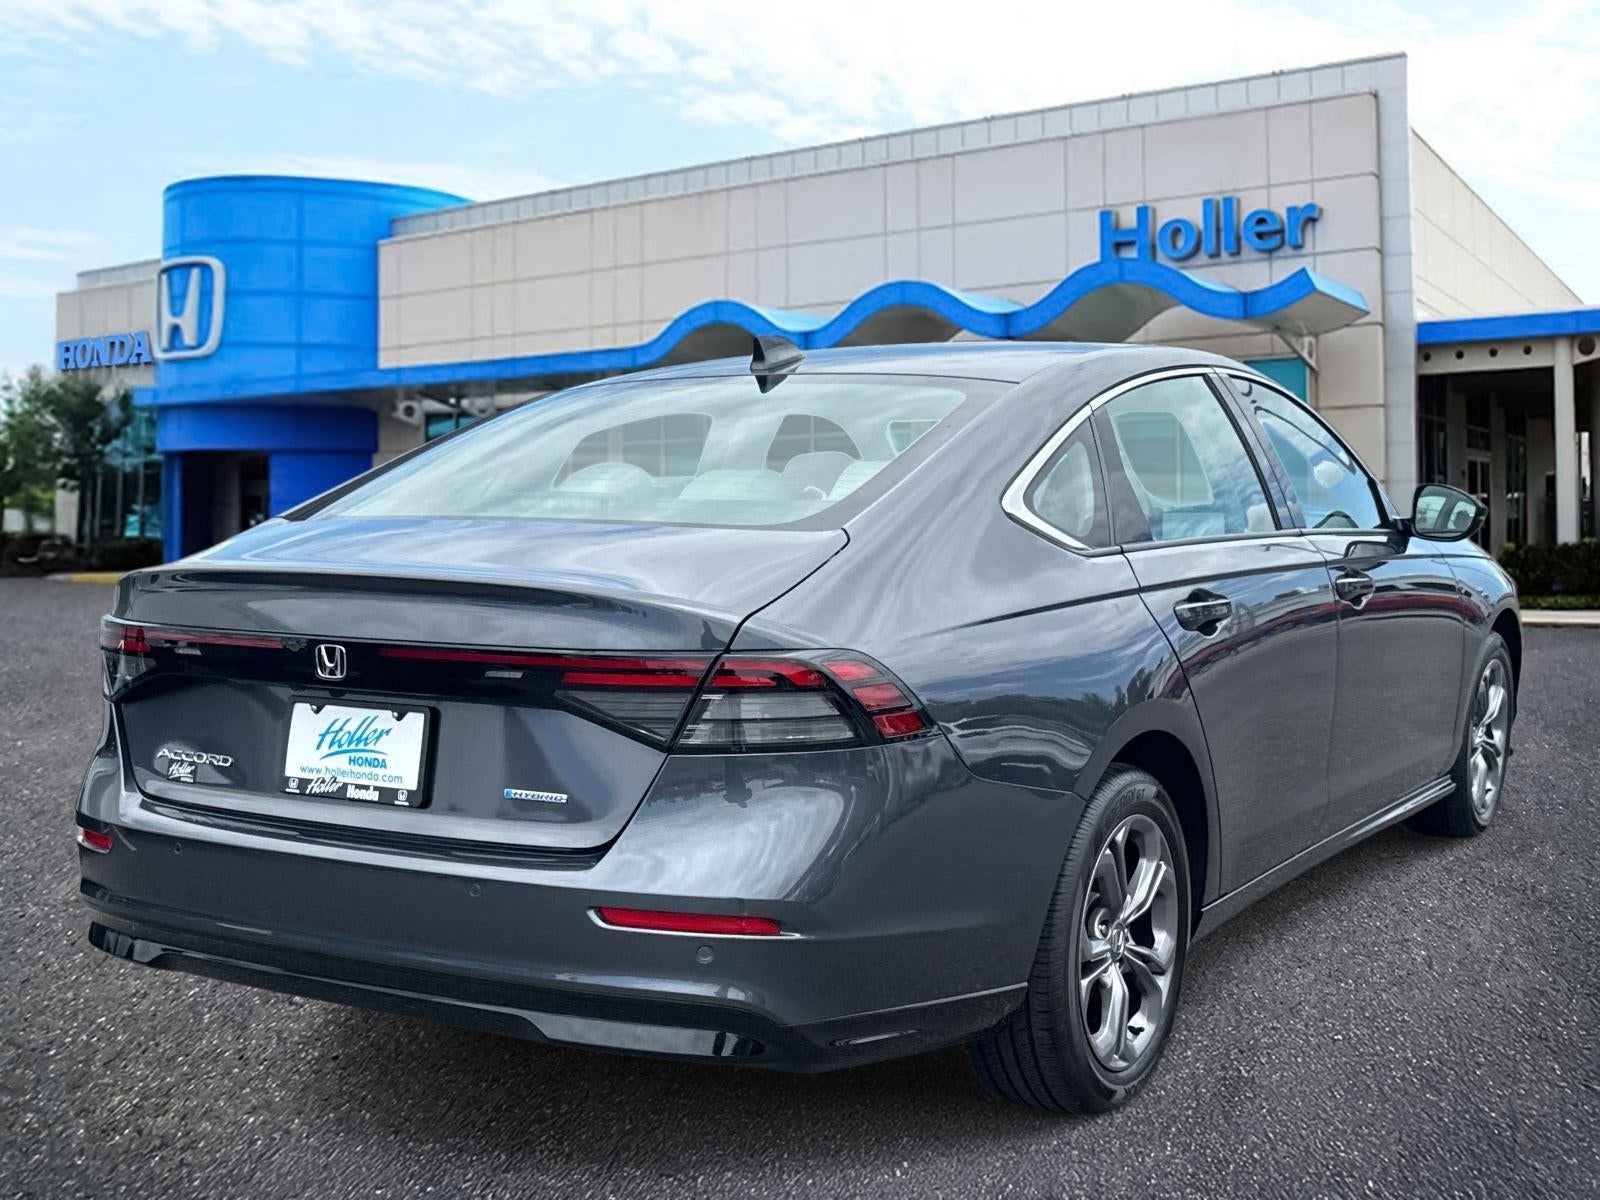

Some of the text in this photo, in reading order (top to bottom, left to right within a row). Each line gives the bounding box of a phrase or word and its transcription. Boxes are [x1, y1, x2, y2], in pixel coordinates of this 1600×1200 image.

[1099, 196, 1320, 262] Holler
[57, 331, 152, 370] HONDA
[315, 714, 393, 751] Holler
[156, 748, 234, 767] ACCORD
[348, 756, 388, 769] HONDA
[300, 764, 403, 784] www.hollerhonda.com
[305, 776, 380, 802] Holler Honda
